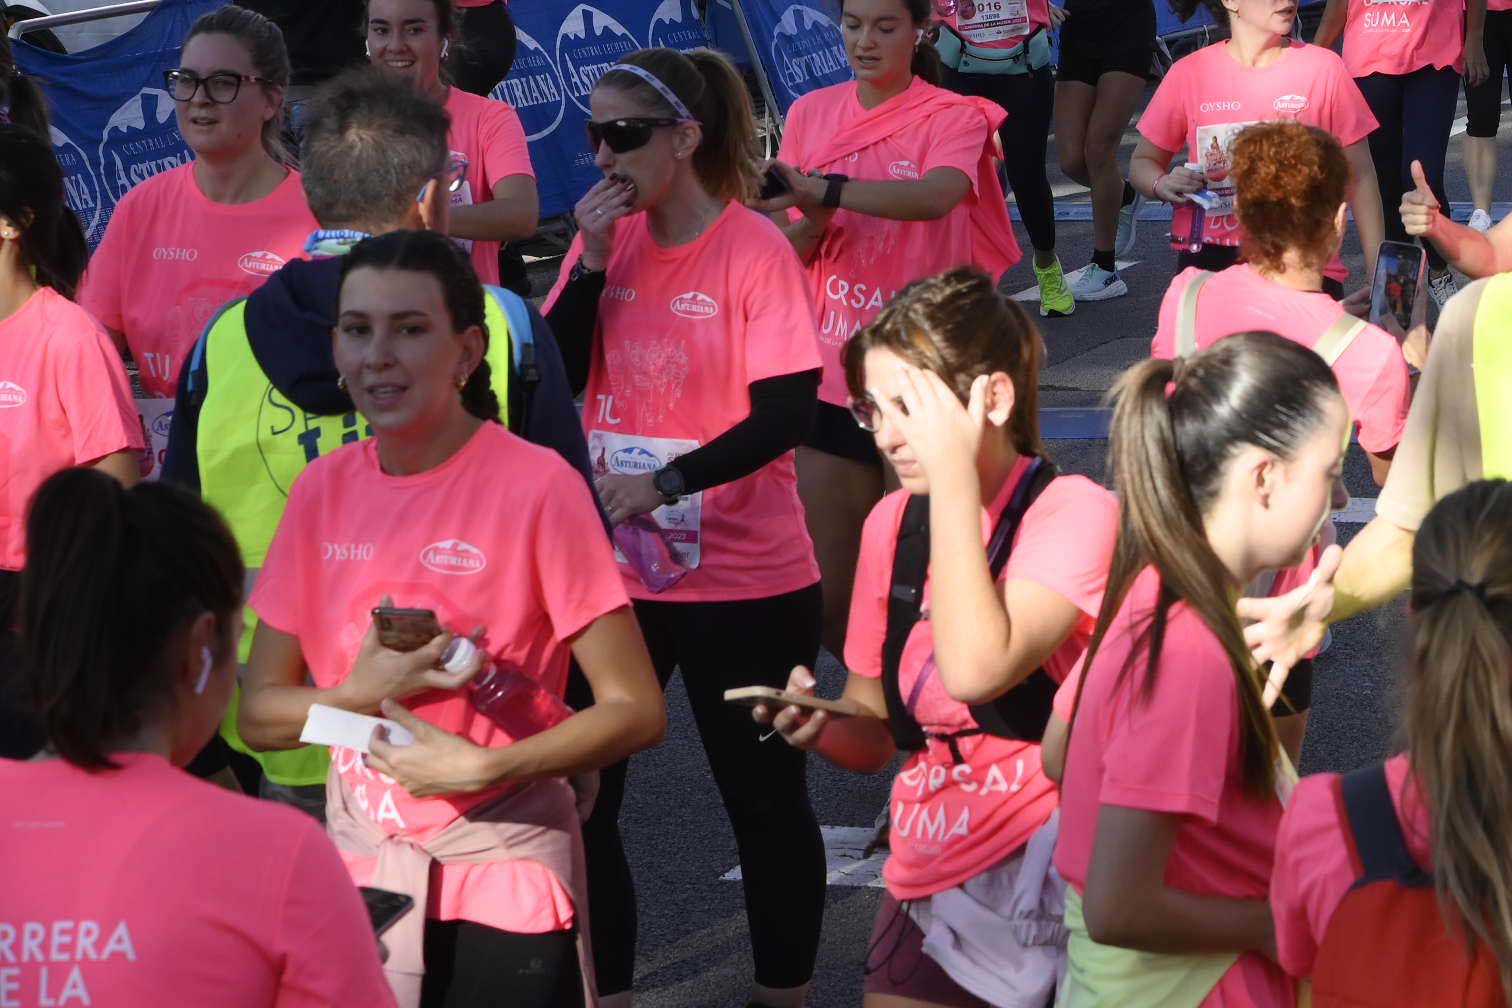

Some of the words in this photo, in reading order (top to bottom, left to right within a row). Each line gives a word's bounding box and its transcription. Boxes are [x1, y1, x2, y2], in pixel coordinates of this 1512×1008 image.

[1363, 12, 1410, 29] SUMA
[1200, 101, 1241, 113] OYSHO
[152, 247, 199, 262] OYSHO
[614, 456, 658, 472] ASTURIANA
[39, 966, 92, 1008] LA
